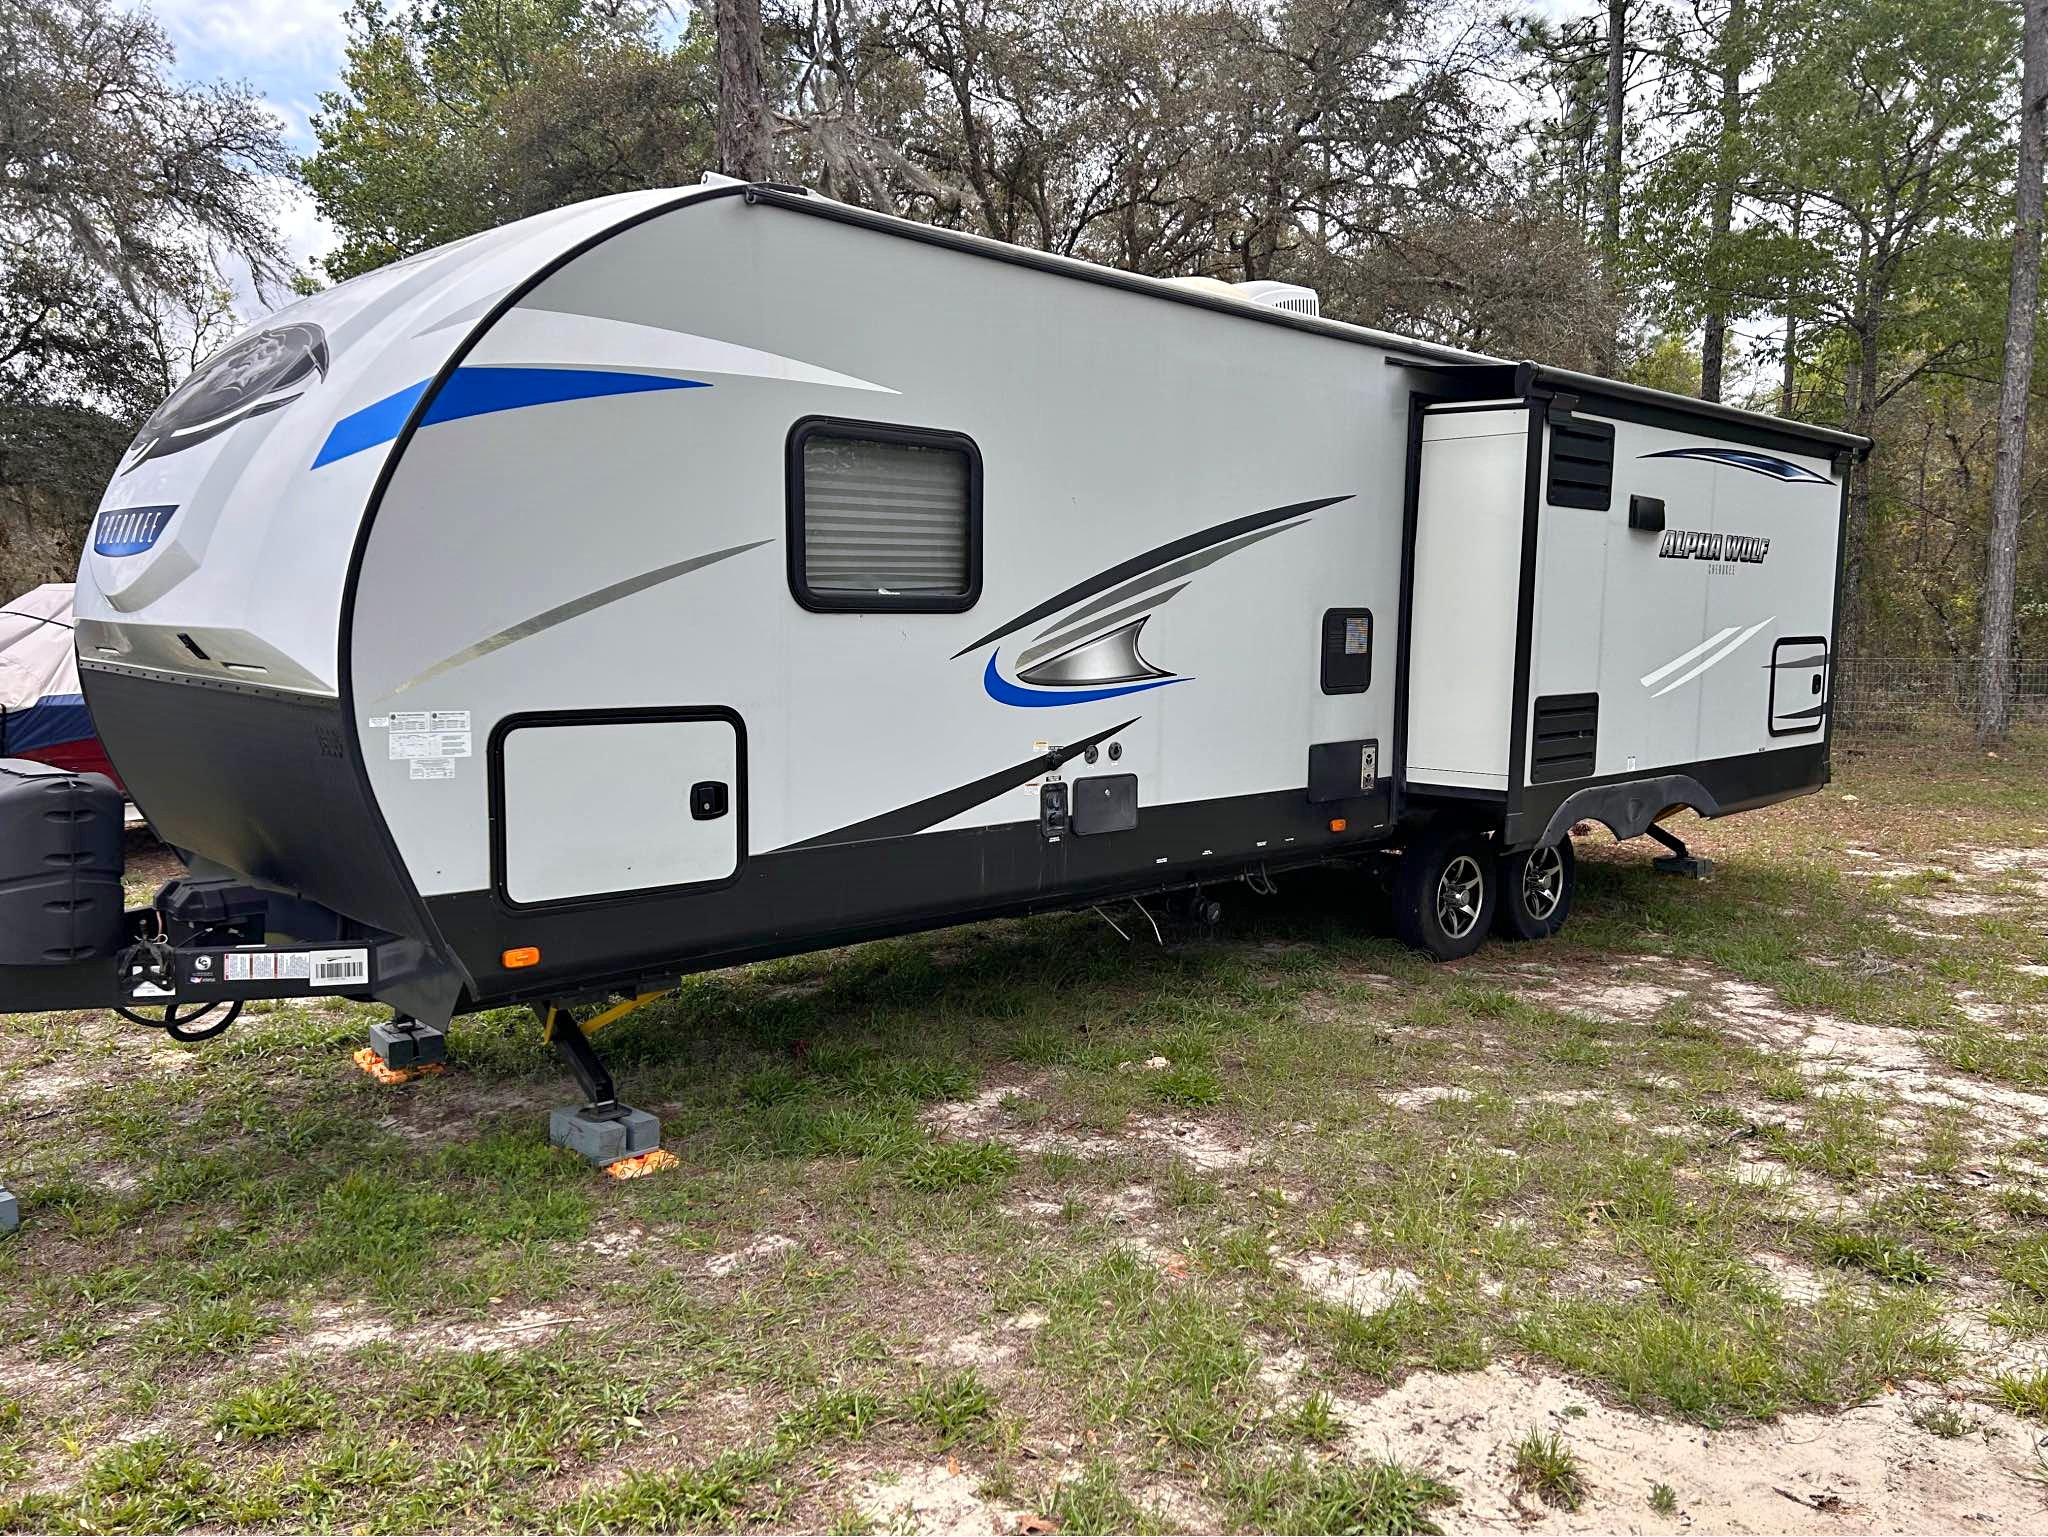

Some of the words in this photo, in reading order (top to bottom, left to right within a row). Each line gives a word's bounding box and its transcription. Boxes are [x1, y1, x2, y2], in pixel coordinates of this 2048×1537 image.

[97, 512, 162, 545] CHEROKEE
[1659, 529, 1723, 561] ALPHA
[1724, 534, 1770, 564] WOLF
